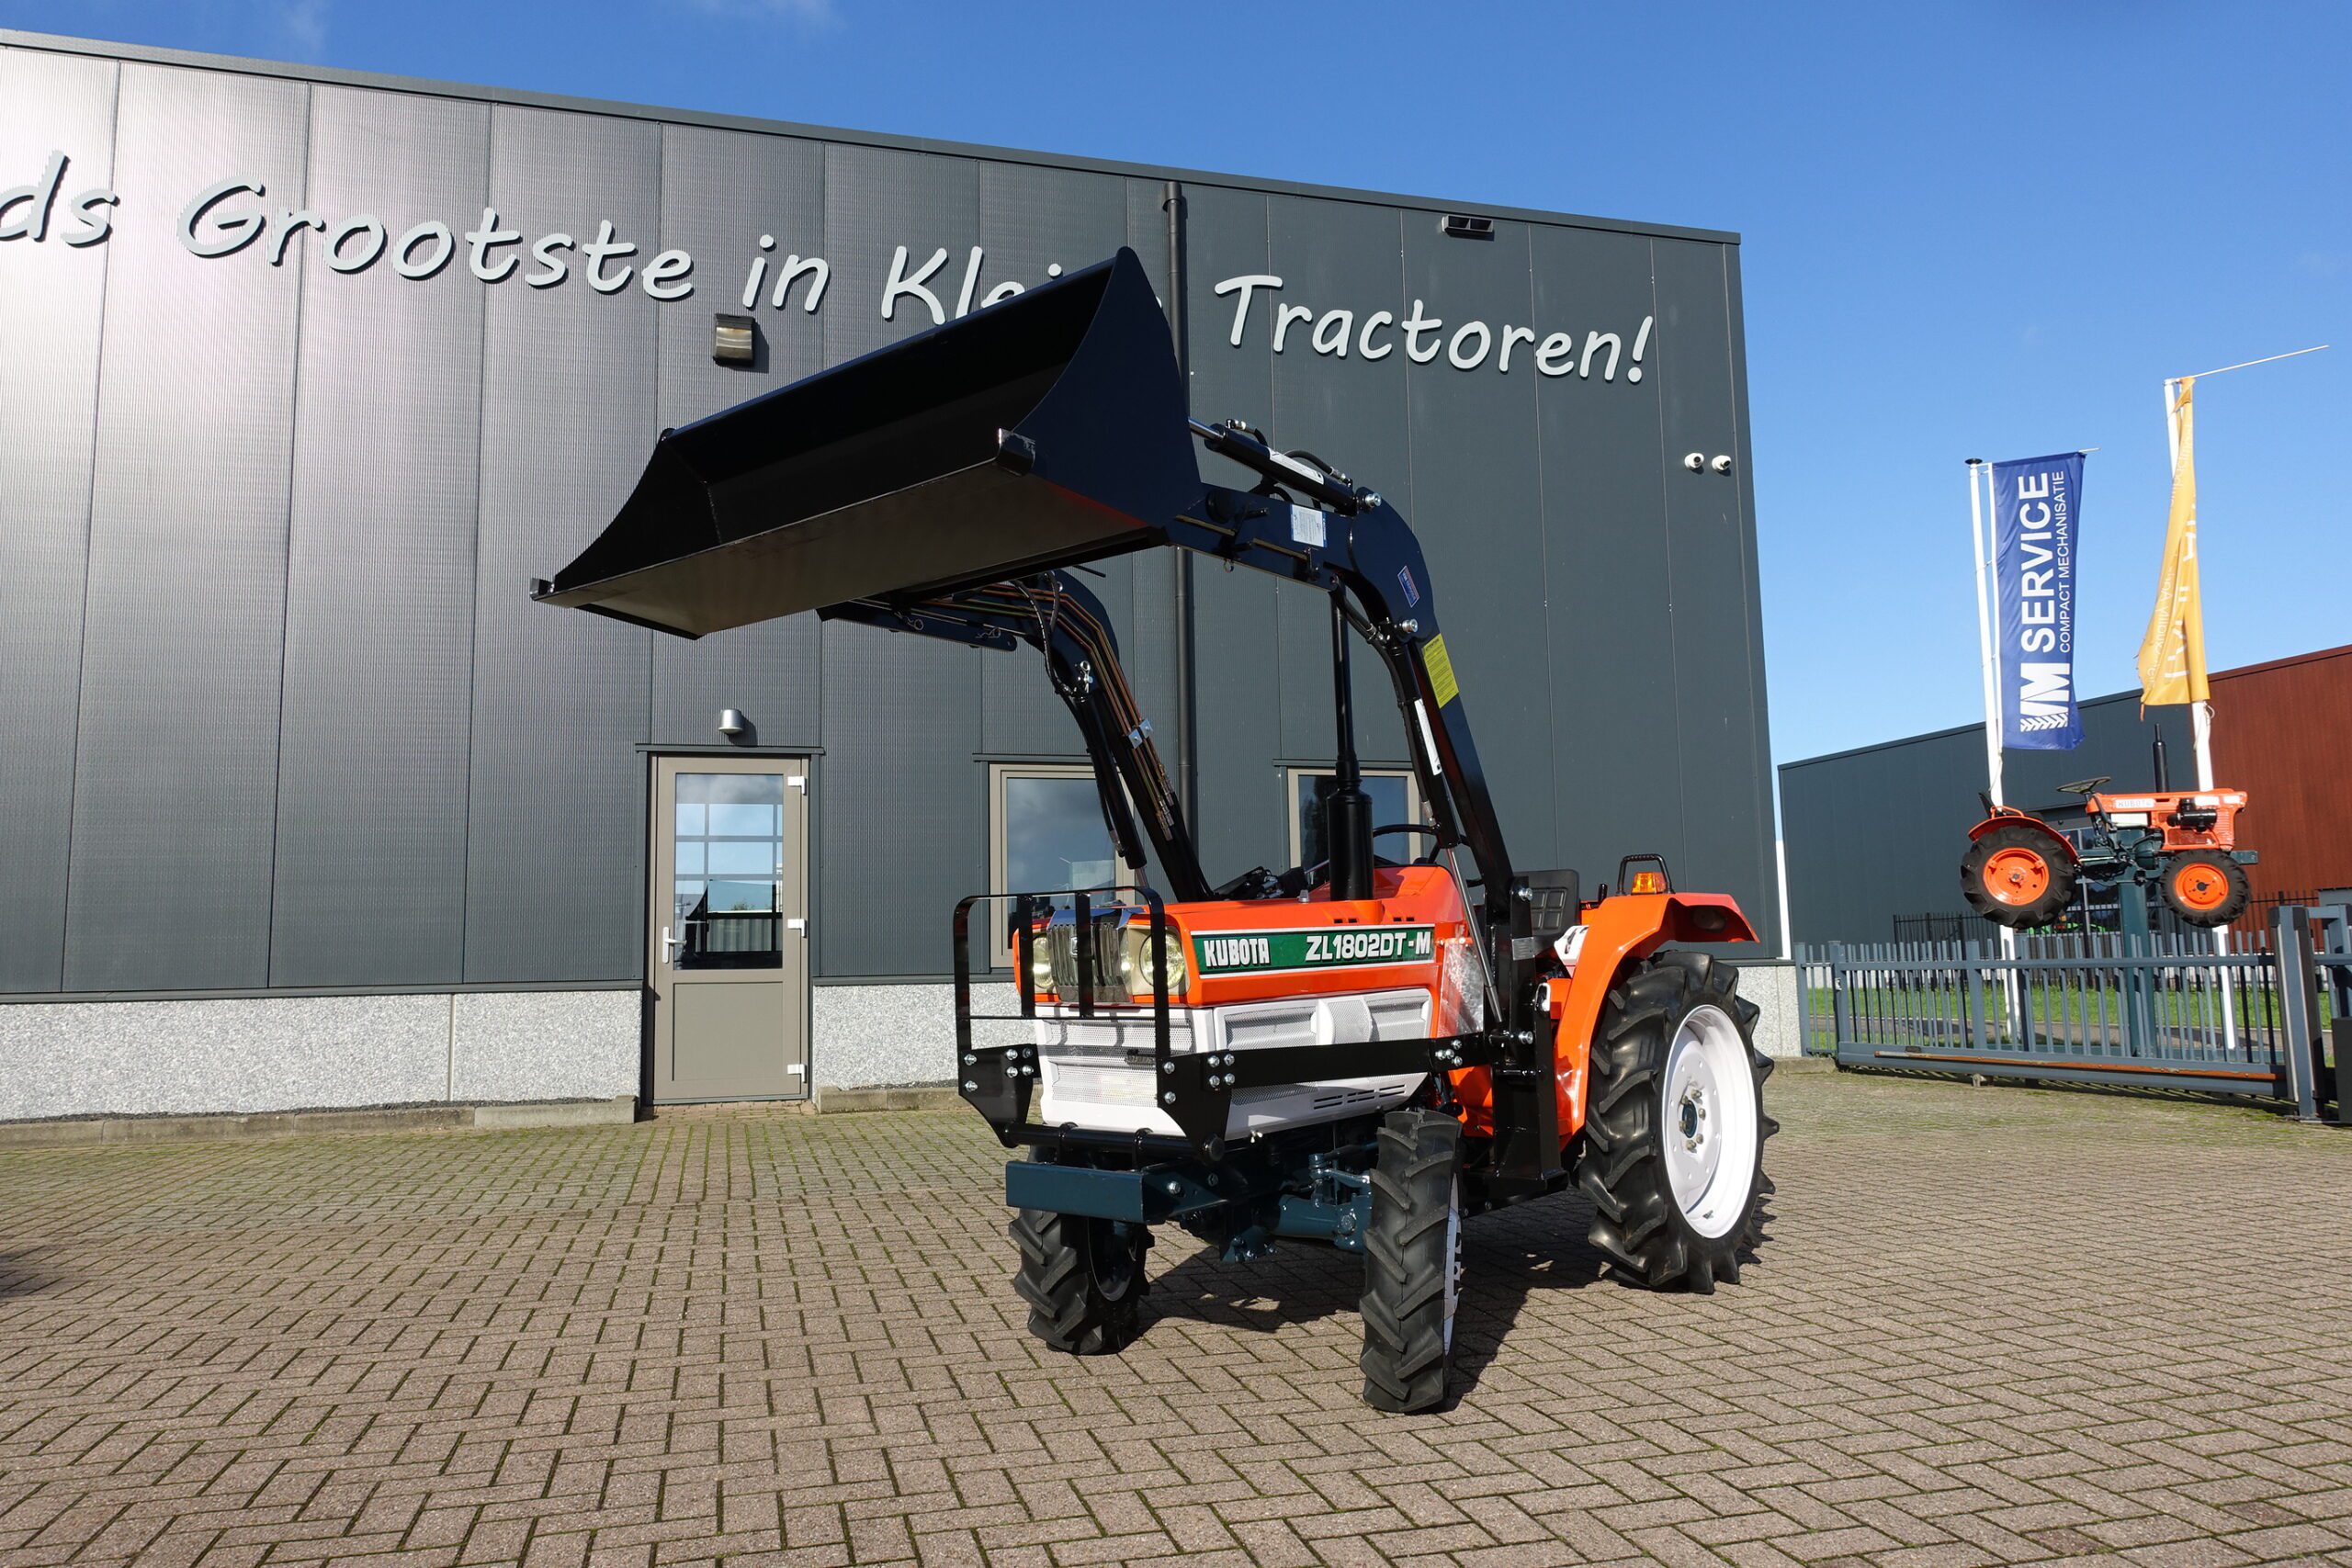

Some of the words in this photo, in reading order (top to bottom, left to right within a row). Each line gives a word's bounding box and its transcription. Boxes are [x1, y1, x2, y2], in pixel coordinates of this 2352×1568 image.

[176, 174, 695, 300] Grootste
[741, 234, 830, 312] in
[1214, 274, 1654, 383] Tractoren!
[2018, 472, 2057, 653] SERVICE
[2052, 469, 2070, 580] MECHANISATIE
[2058, 581, 2072, 654] COMPACT
[1203, 937, 1271, 967] KUBOTA
[1305, 930, 1431, 962] ZL1802DT-M
